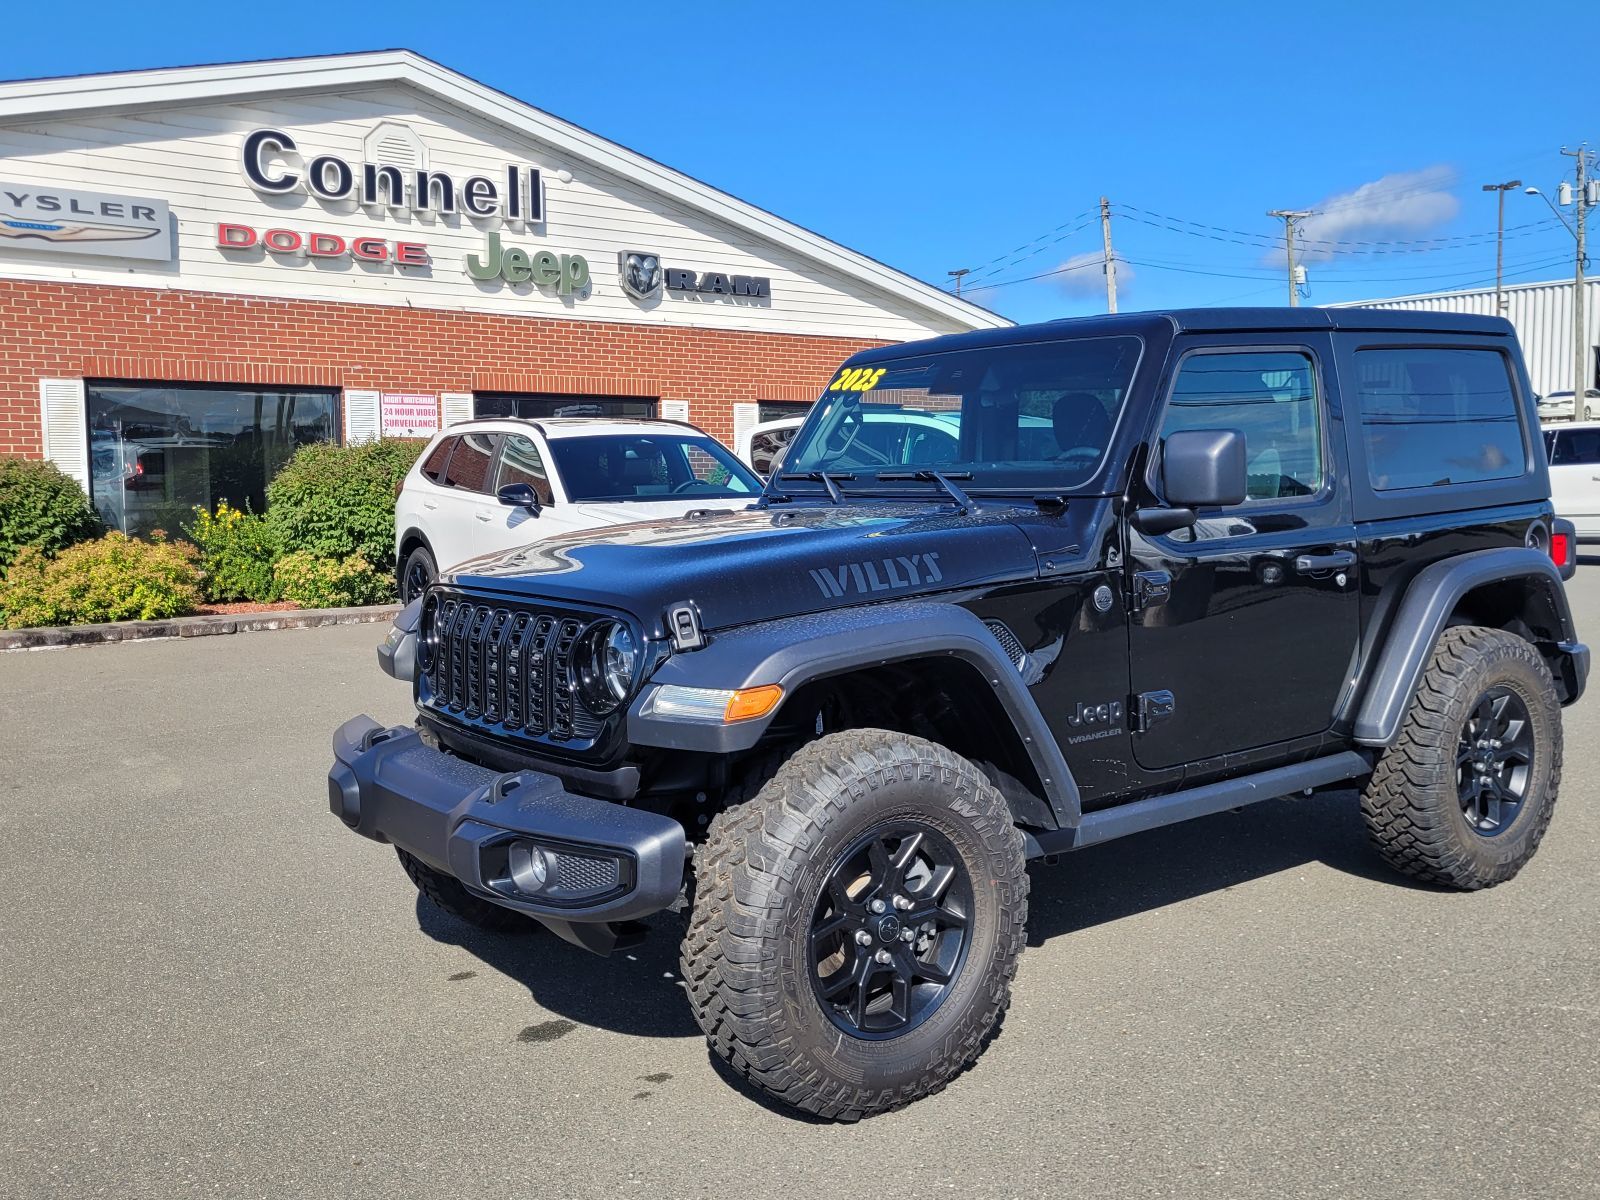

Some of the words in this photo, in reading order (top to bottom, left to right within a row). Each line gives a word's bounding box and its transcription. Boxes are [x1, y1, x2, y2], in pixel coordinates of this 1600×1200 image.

[240, 127, 543, 224] Connell
[216, 222, 428, 266] DODGE
[464, 231, 589, 296] Jeep
[664, 267, 770, 297] RAM
[829, 368, 886, 391] 2025
[384, 407, 393, 416] 24
[395, 408, 414, 416] HOUR
[416, 408, 436, 416] VIDEO
[384, 419, 436, 427] SURVEILLANCE
[809, 552, 942, 598] WILLYS
[1068, 701, 1123, 727] Jeep
[1068, 728, 1122, 745] WRANGLER
